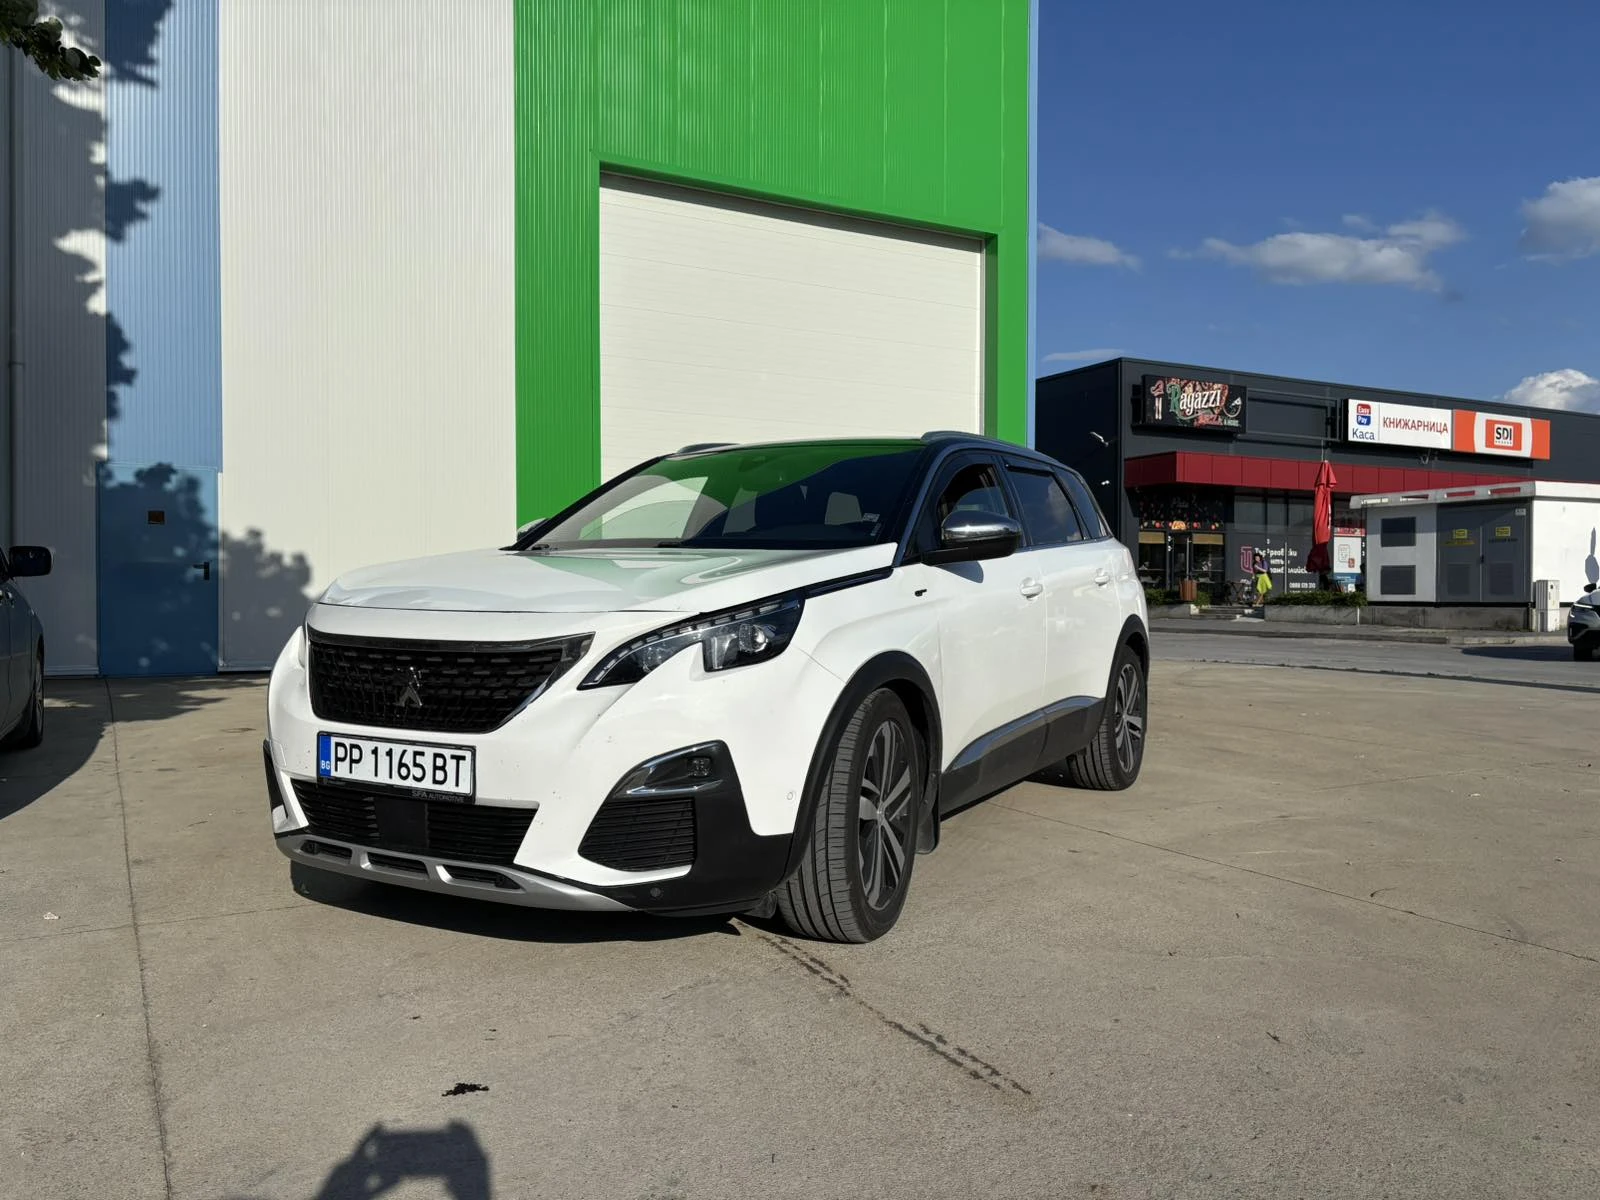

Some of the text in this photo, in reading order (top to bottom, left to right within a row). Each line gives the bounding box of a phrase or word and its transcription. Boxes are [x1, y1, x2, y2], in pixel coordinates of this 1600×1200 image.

[1166, 383, 1222, 416] Ragazzi
[1357, 405, 1370, 414] Easy
[1357, 415, 1368, 425] Pay
[1383, 417, 1448, 434] КНИЖАРНИЦА
[1352, 427, 1375, 440] Каса
[1495, 426, 1512, 441] SDI
[320, 760, 331, 770] BG
[334, 741, 467, 788] PP 1165 BT
